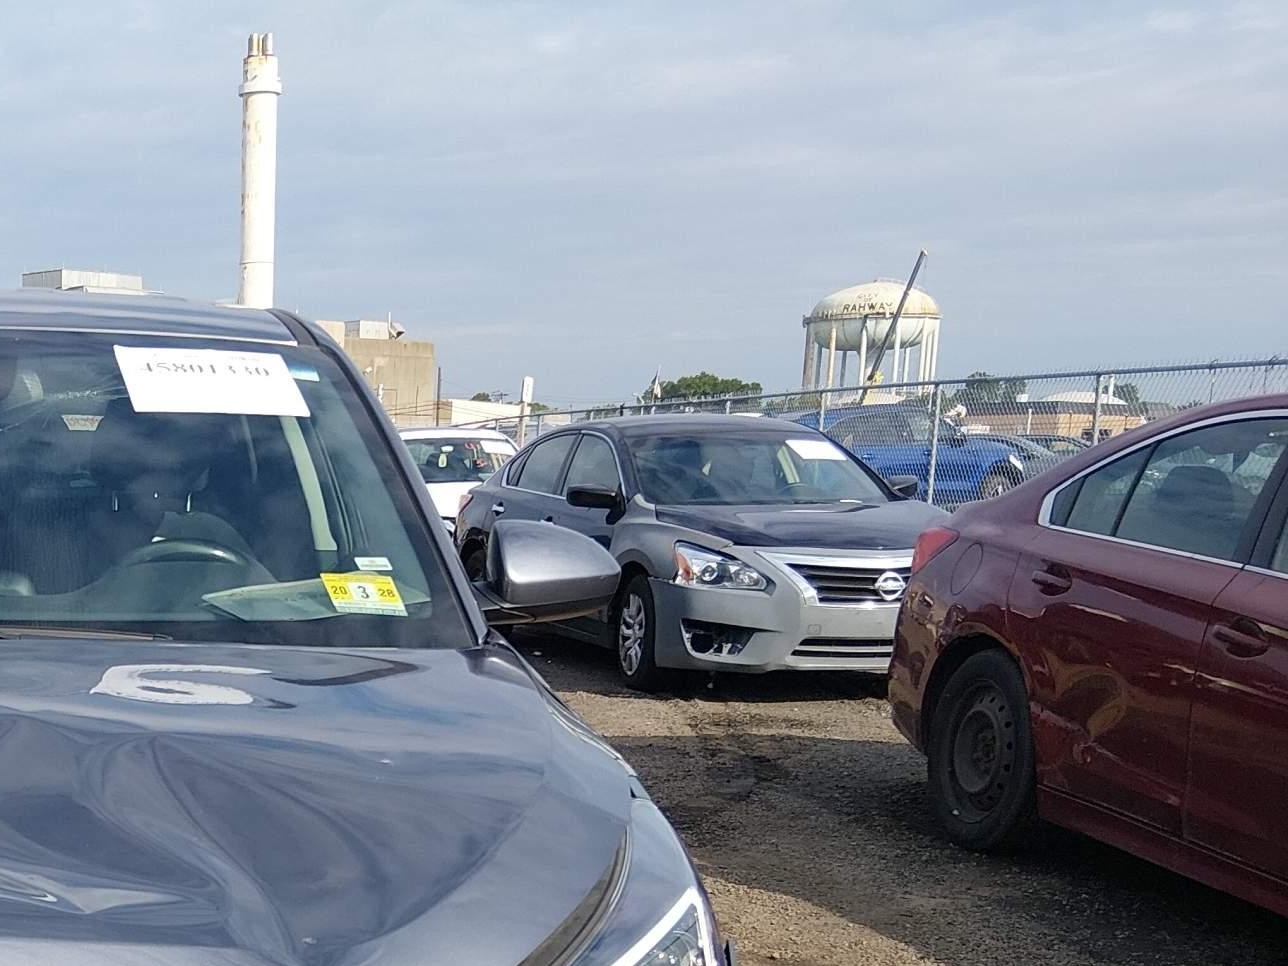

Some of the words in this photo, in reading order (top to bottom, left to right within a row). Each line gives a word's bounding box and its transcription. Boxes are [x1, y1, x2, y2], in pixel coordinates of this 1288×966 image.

[842, 302, 893, 313] RAHWAY
[330, 585, 348, 595] 20
[357, 585, 370, 599] 3
[377, 588, 395, 598] 28
